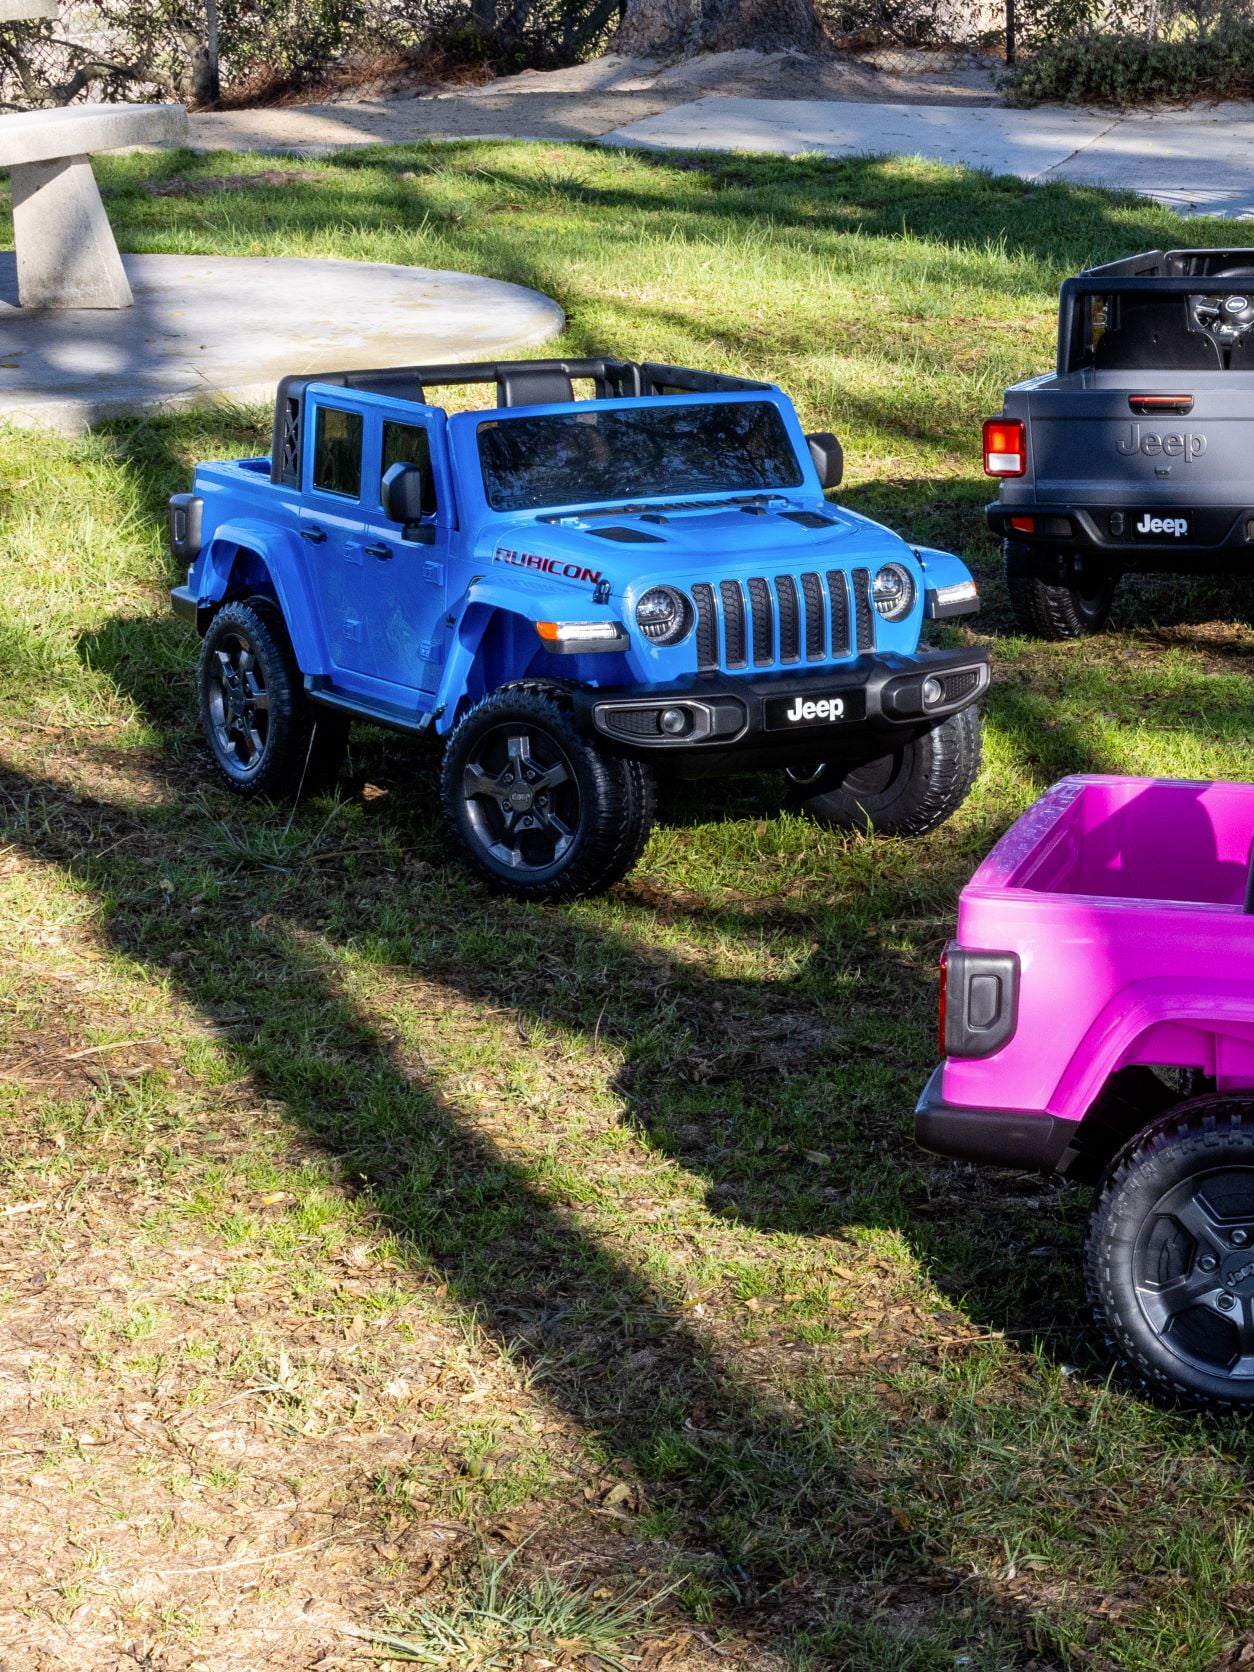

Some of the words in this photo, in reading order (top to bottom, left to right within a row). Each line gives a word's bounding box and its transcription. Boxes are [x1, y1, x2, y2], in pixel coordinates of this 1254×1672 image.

[1116, 422, 1207, 464] Jeep
[1137, 514, 1188, 537] Jeep
[495, 547, 602, 585] RUBICON
[787, 697, 844, 721] Jeep
